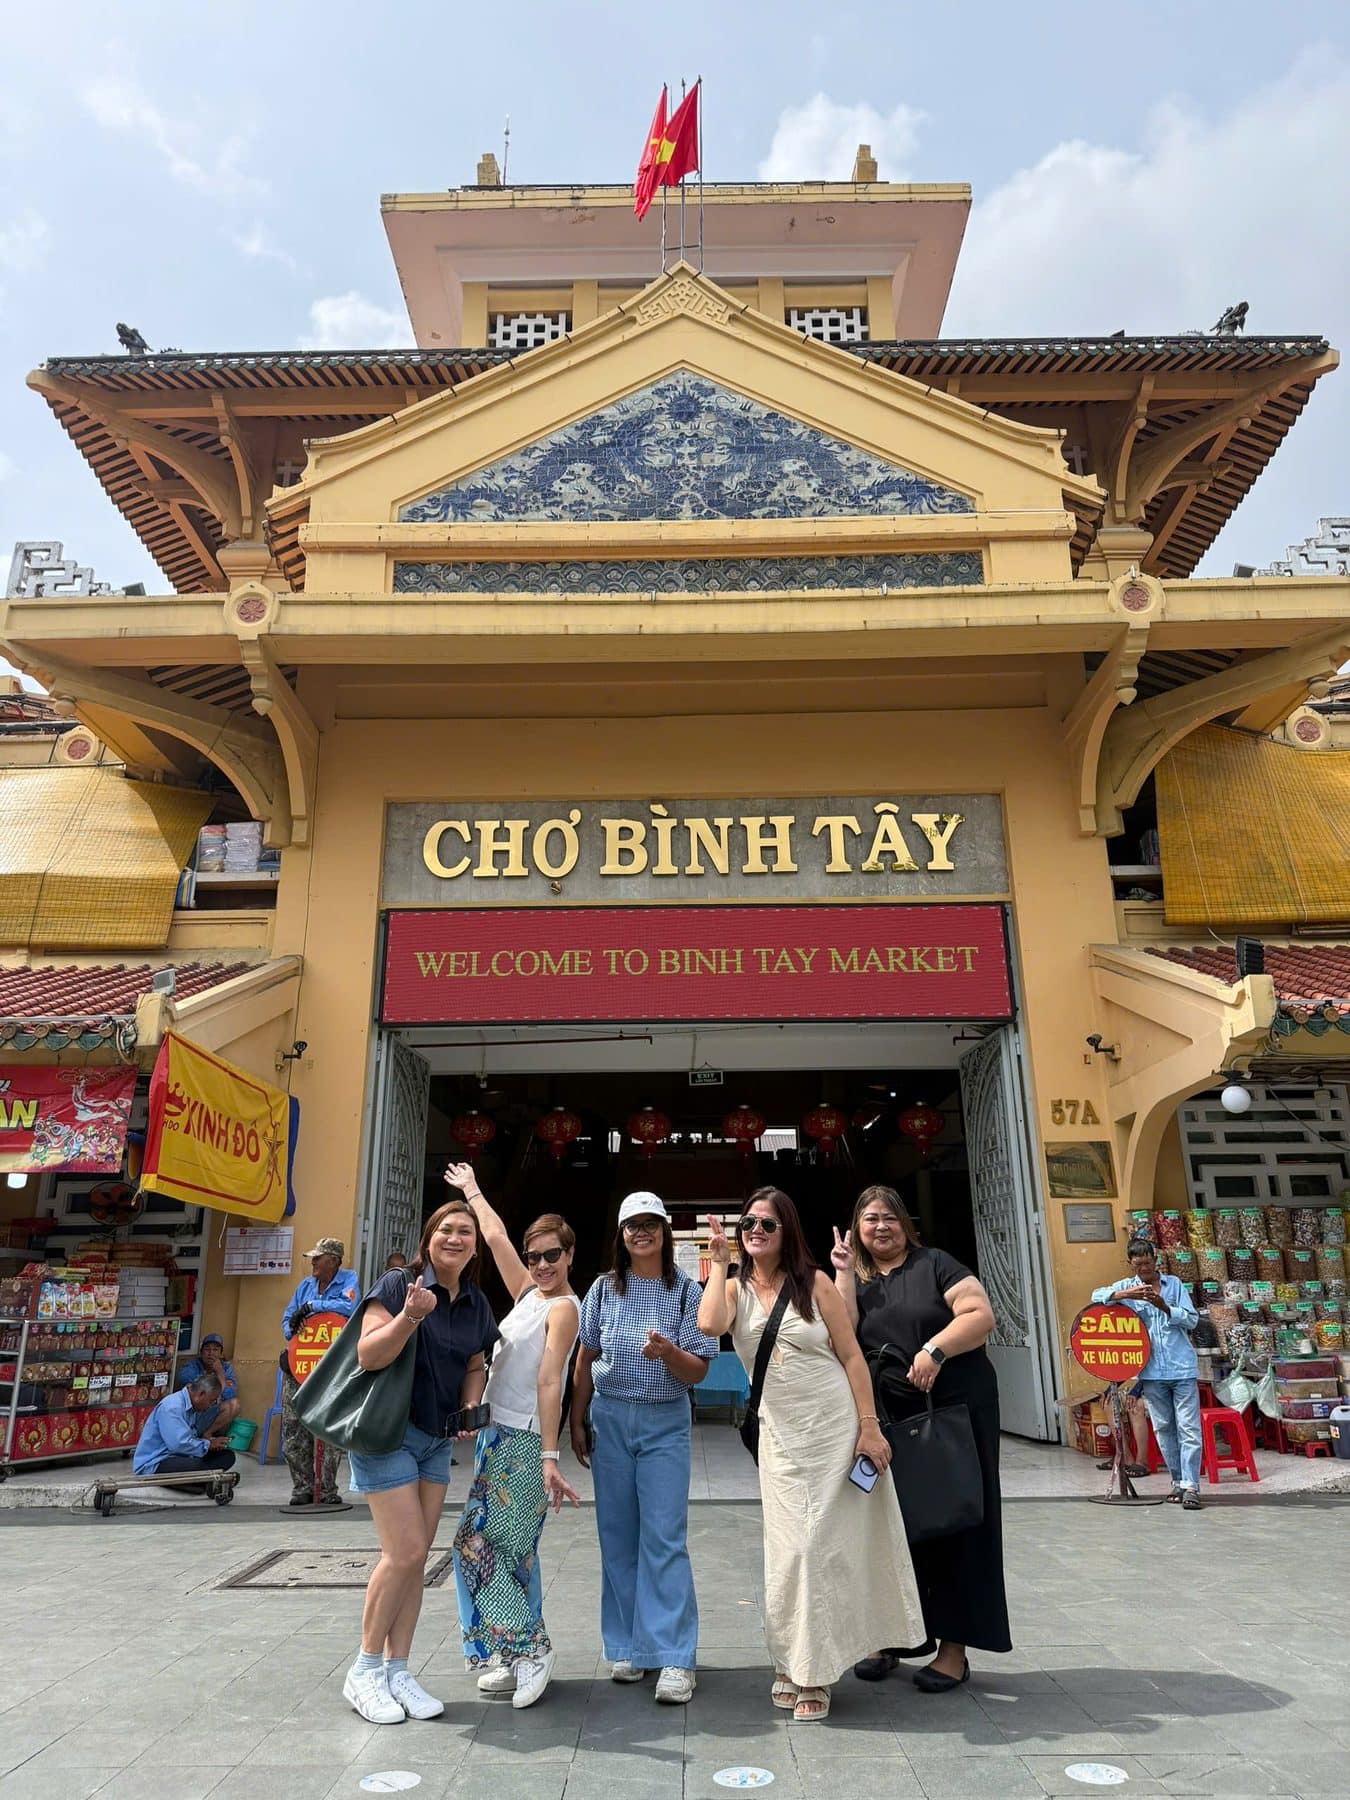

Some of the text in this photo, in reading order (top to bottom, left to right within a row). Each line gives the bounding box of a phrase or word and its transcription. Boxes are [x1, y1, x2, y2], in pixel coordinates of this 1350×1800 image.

[422, 802, 966, 895] CHỢ BÌNH TÂY
[413, 946, 980, 978] WELCOME TO BINH TAY MARKET
[1050, 1098, 1101, 1125] 57A
[1080, 1311, 1141, 1334] CẤM
[295, 1360, 308, 1374] XE
[1082, 1348, 1143, 1368] XE VÀO CHỢ
